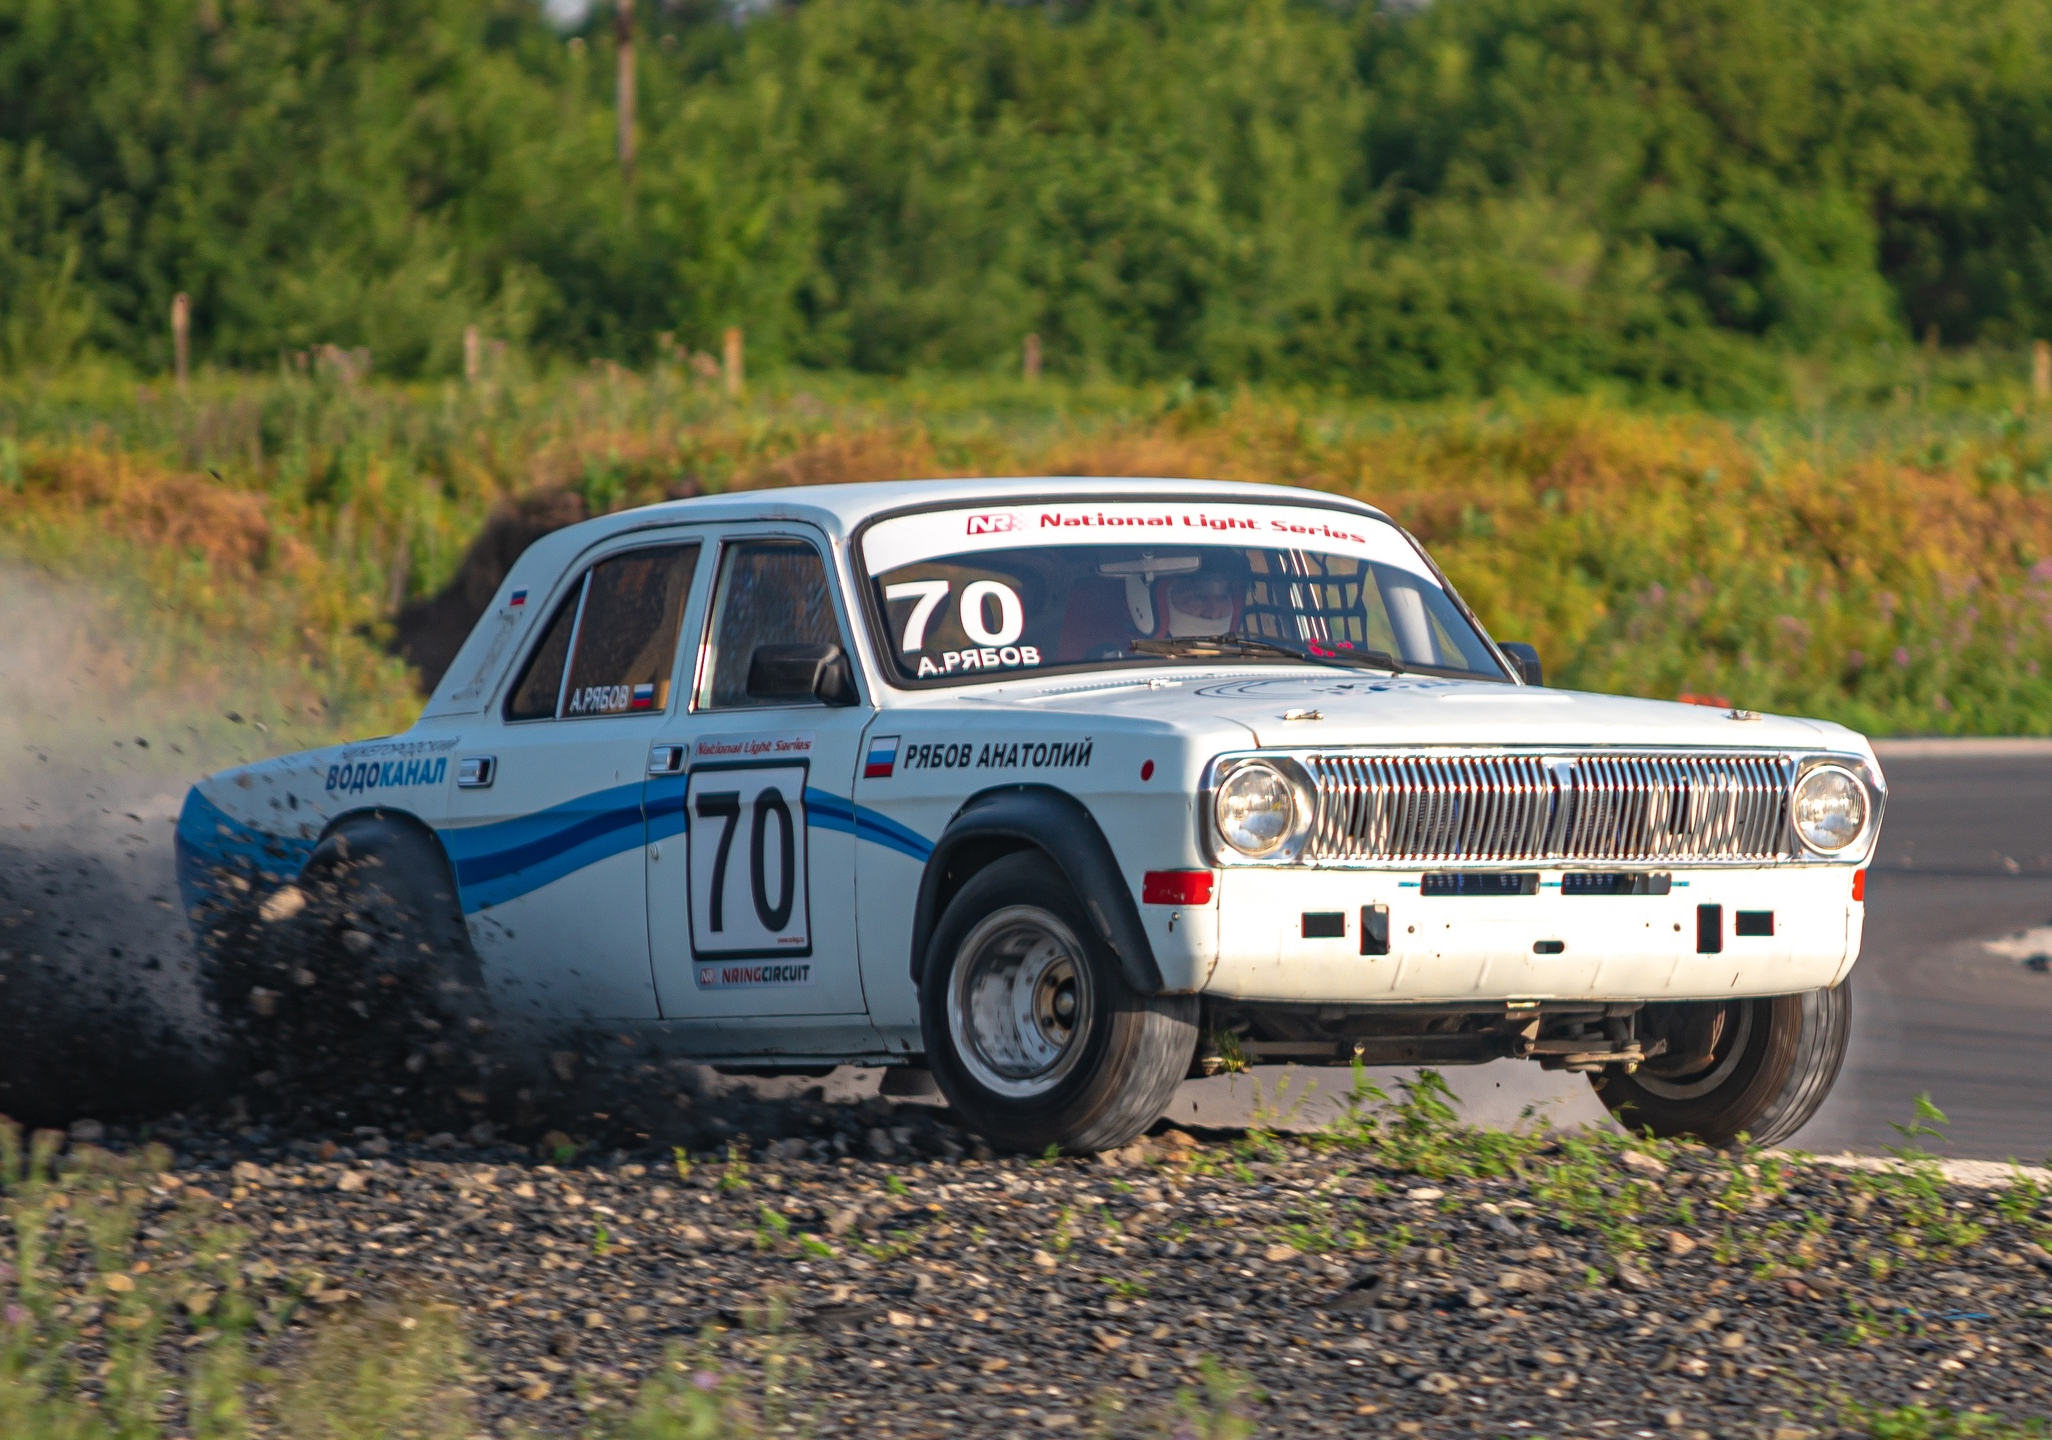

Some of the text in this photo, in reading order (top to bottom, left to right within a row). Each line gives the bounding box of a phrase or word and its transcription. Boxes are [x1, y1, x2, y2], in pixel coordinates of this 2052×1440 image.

[1040, 513, 1366, 543] National Light Series
[885, 580, 1024, 654] 70
[918, 646, 1041, 679] А.РЯБОВ
[569, 684, 629, 713] А.РЯБОВ
[695, 736, 811, 756] National Light Series
[904, 736, 1093, 769] РЯБОВ АНАТОЛИЙ
[325, 757, 447, 794] ВОДОКАНАЛ
[695, 786, 795, 932] 70
[722, 965, 810, 985] NRINGCIRCUIT
